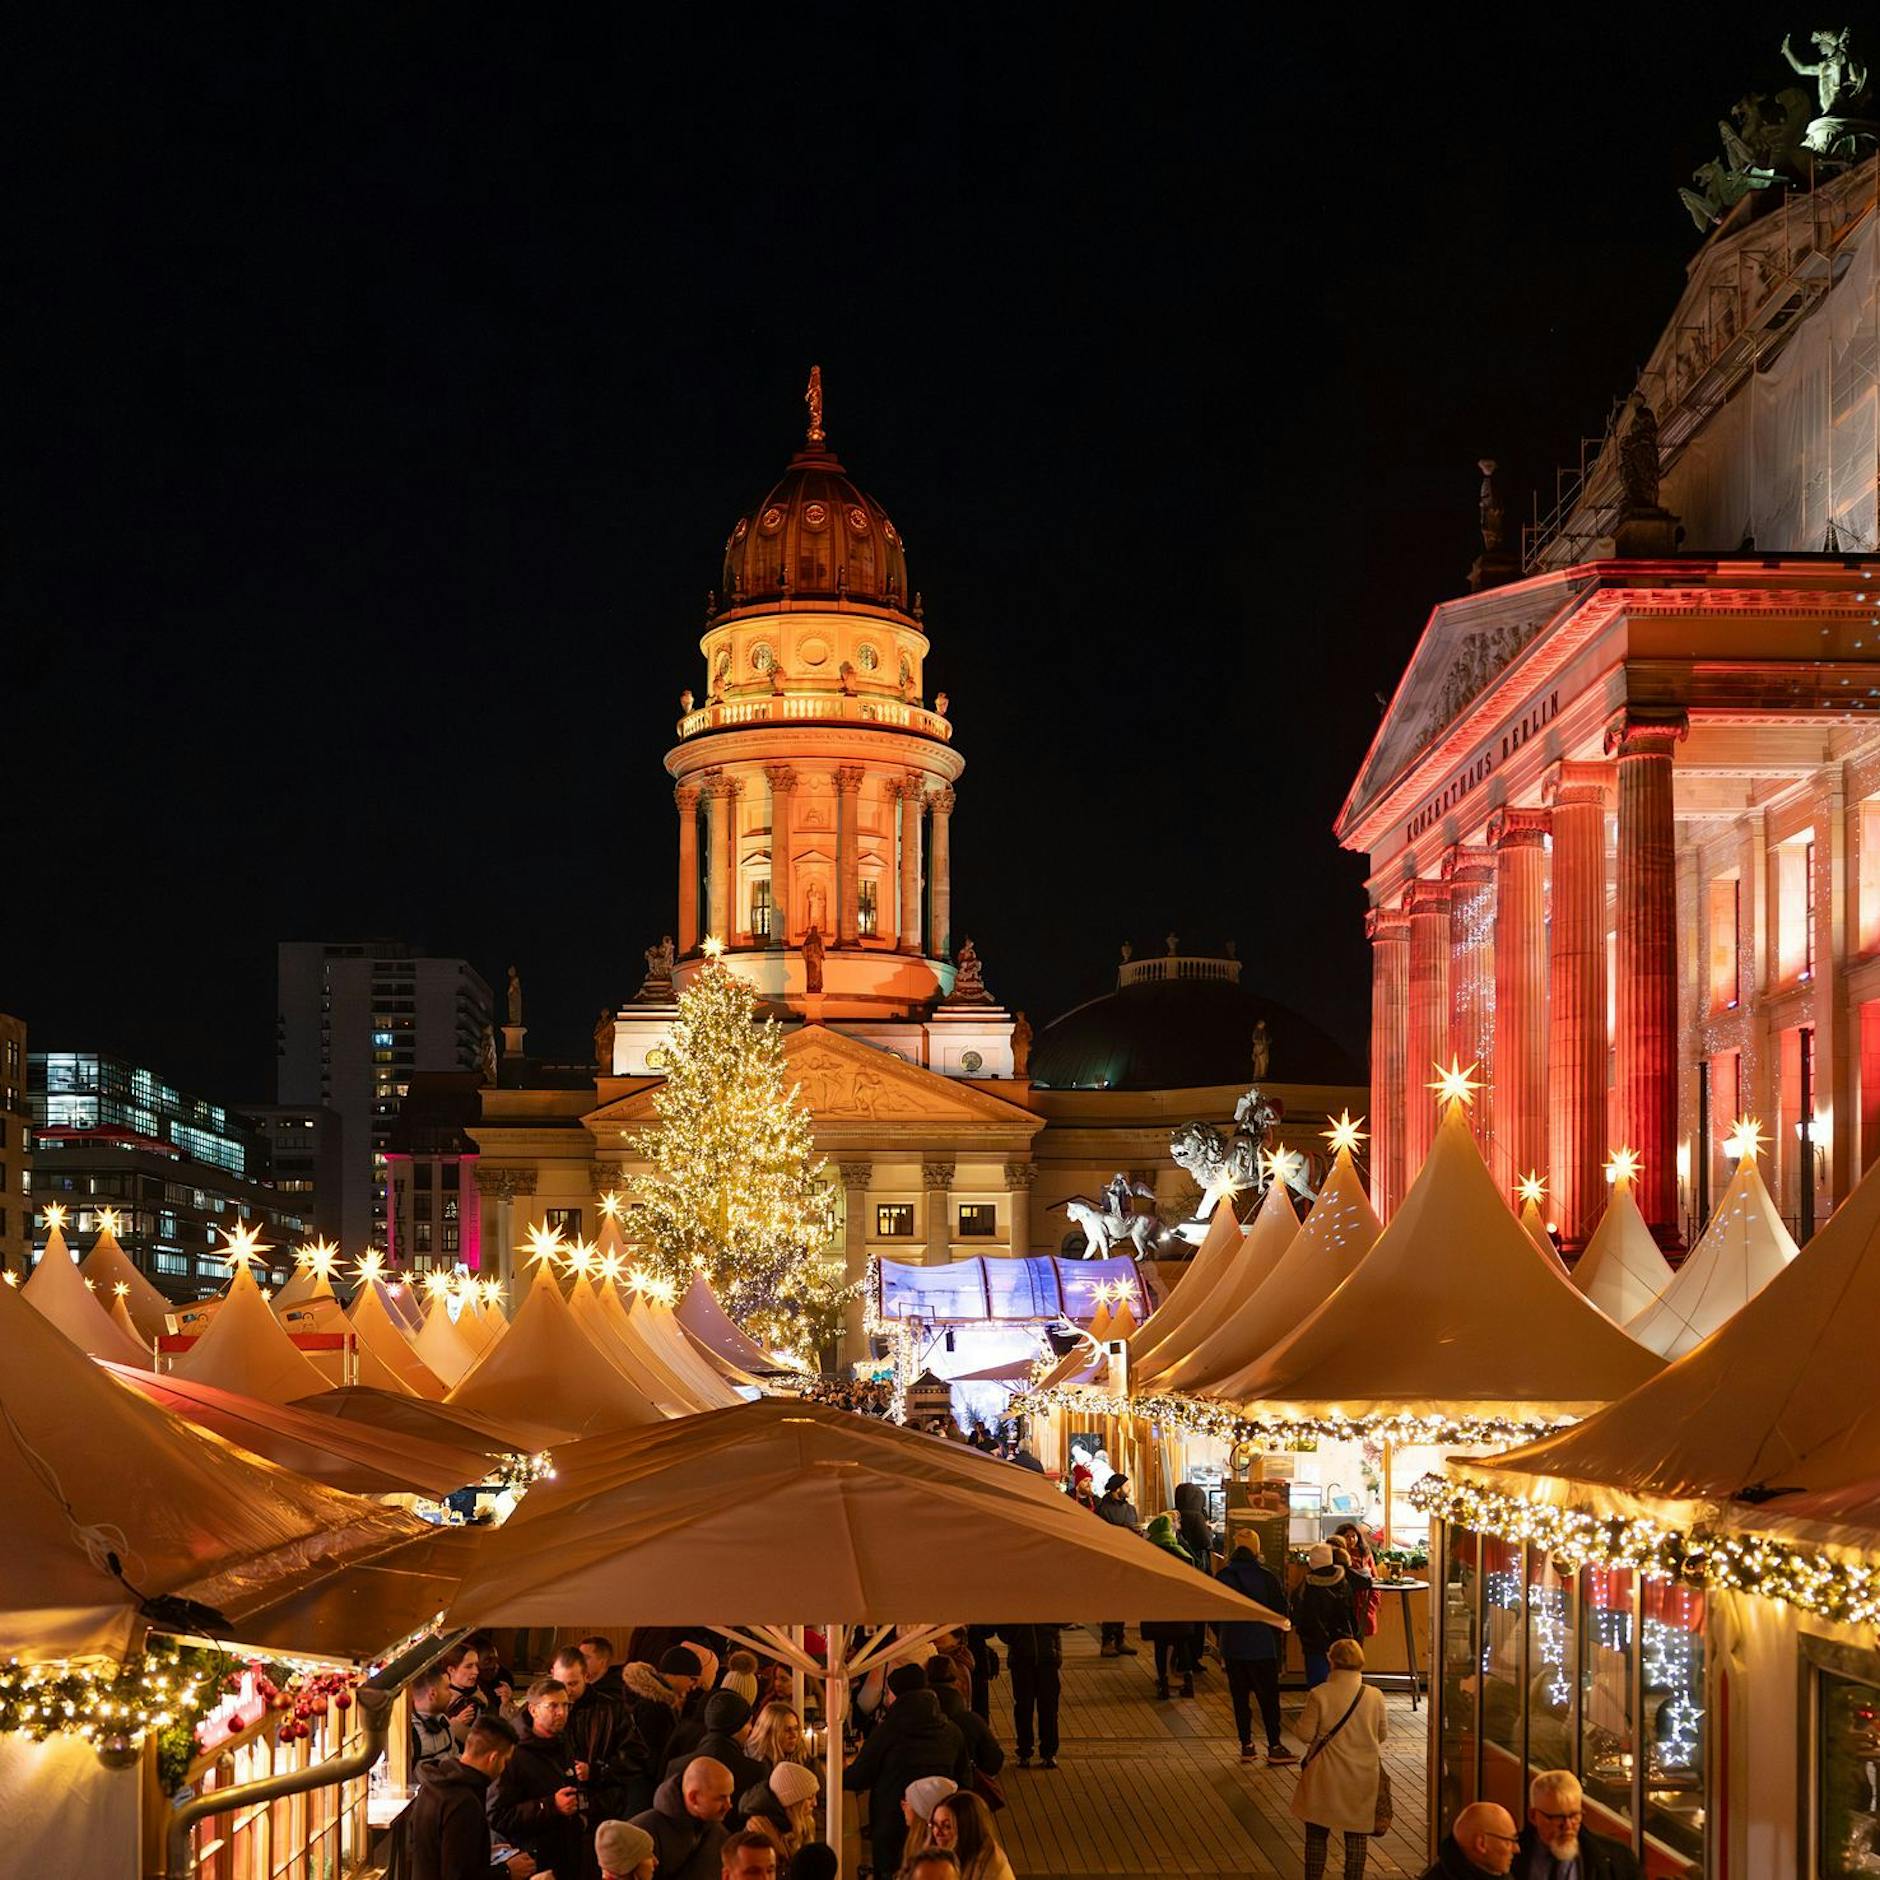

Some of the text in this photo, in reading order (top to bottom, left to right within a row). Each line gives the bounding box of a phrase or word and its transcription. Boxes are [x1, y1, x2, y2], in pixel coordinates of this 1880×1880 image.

[1407, 690, 1560, 842] KONZERTHAUS BERLIN
[394, 1179, 406, 1261] HILTON
